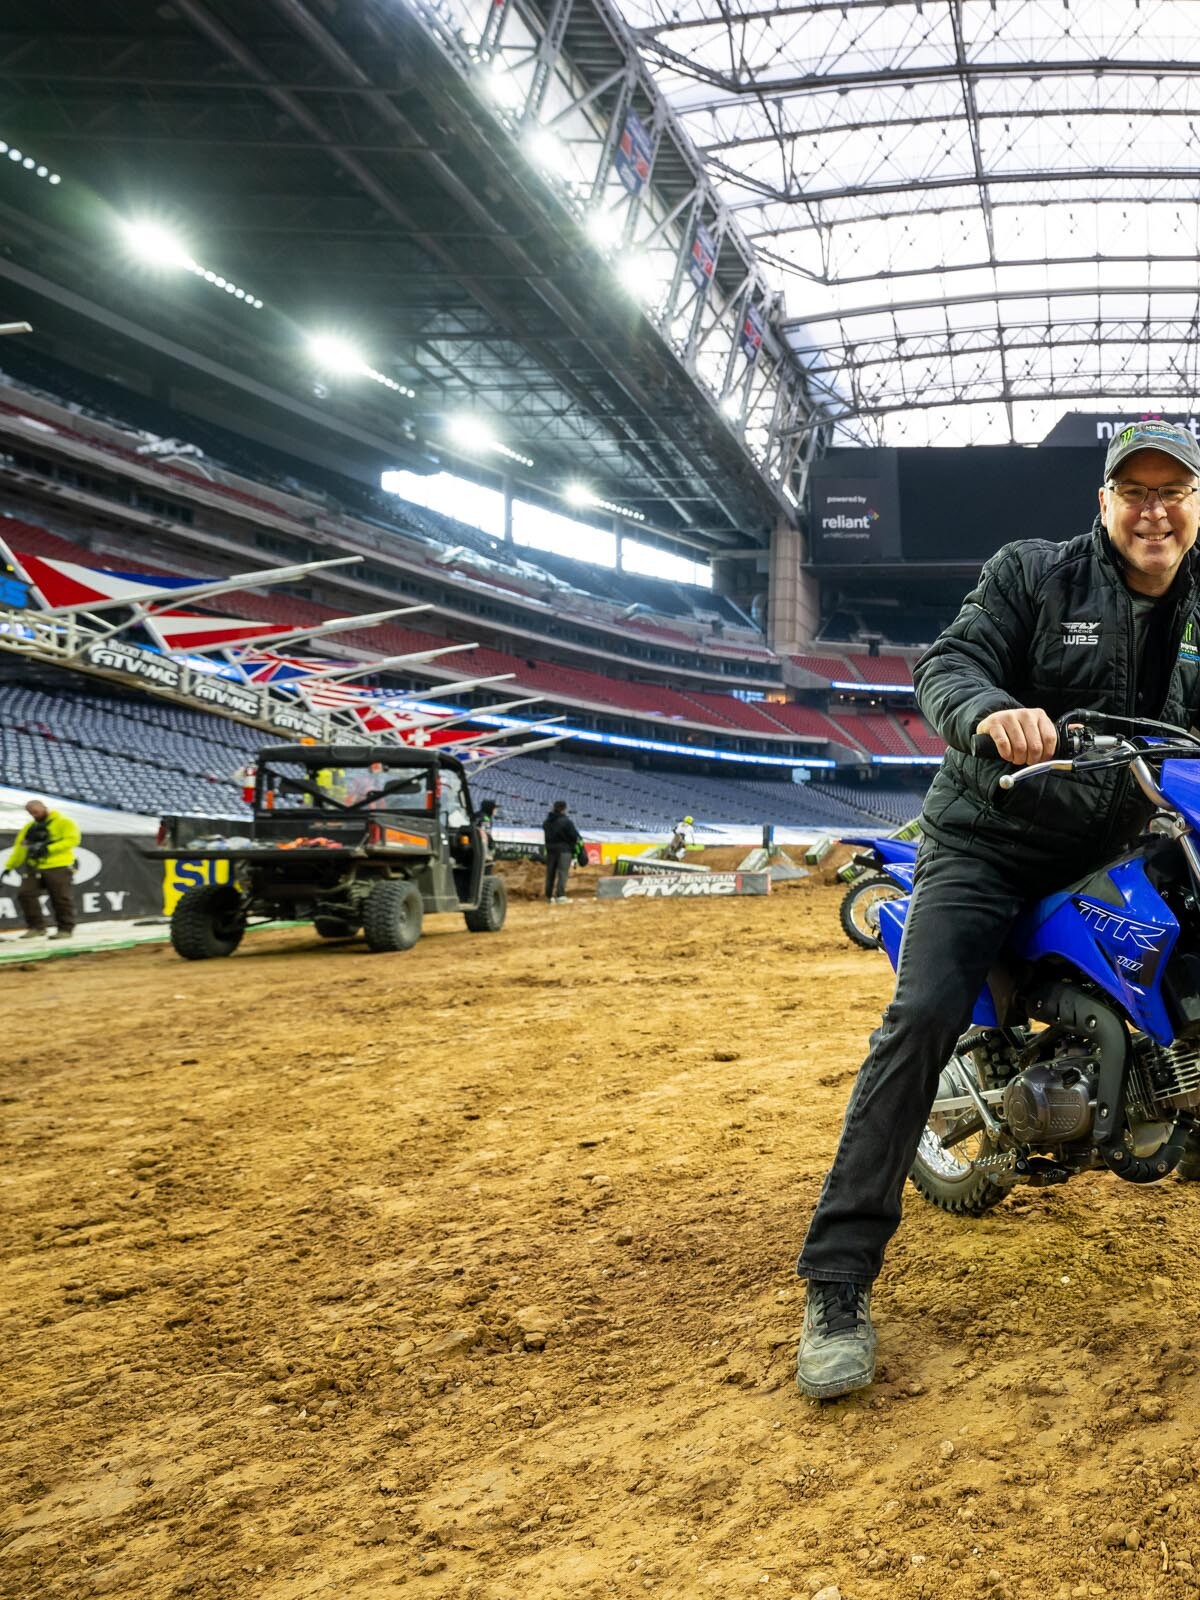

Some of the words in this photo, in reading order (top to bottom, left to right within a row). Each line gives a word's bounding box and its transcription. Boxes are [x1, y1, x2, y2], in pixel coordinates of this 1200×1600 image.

[1096, 421, 1133, 439] nr
[822, 514, 870, 529] reliant
[1061, 622, 1101, 630] FLY
[1063, 634, 1099, 646] WPS
